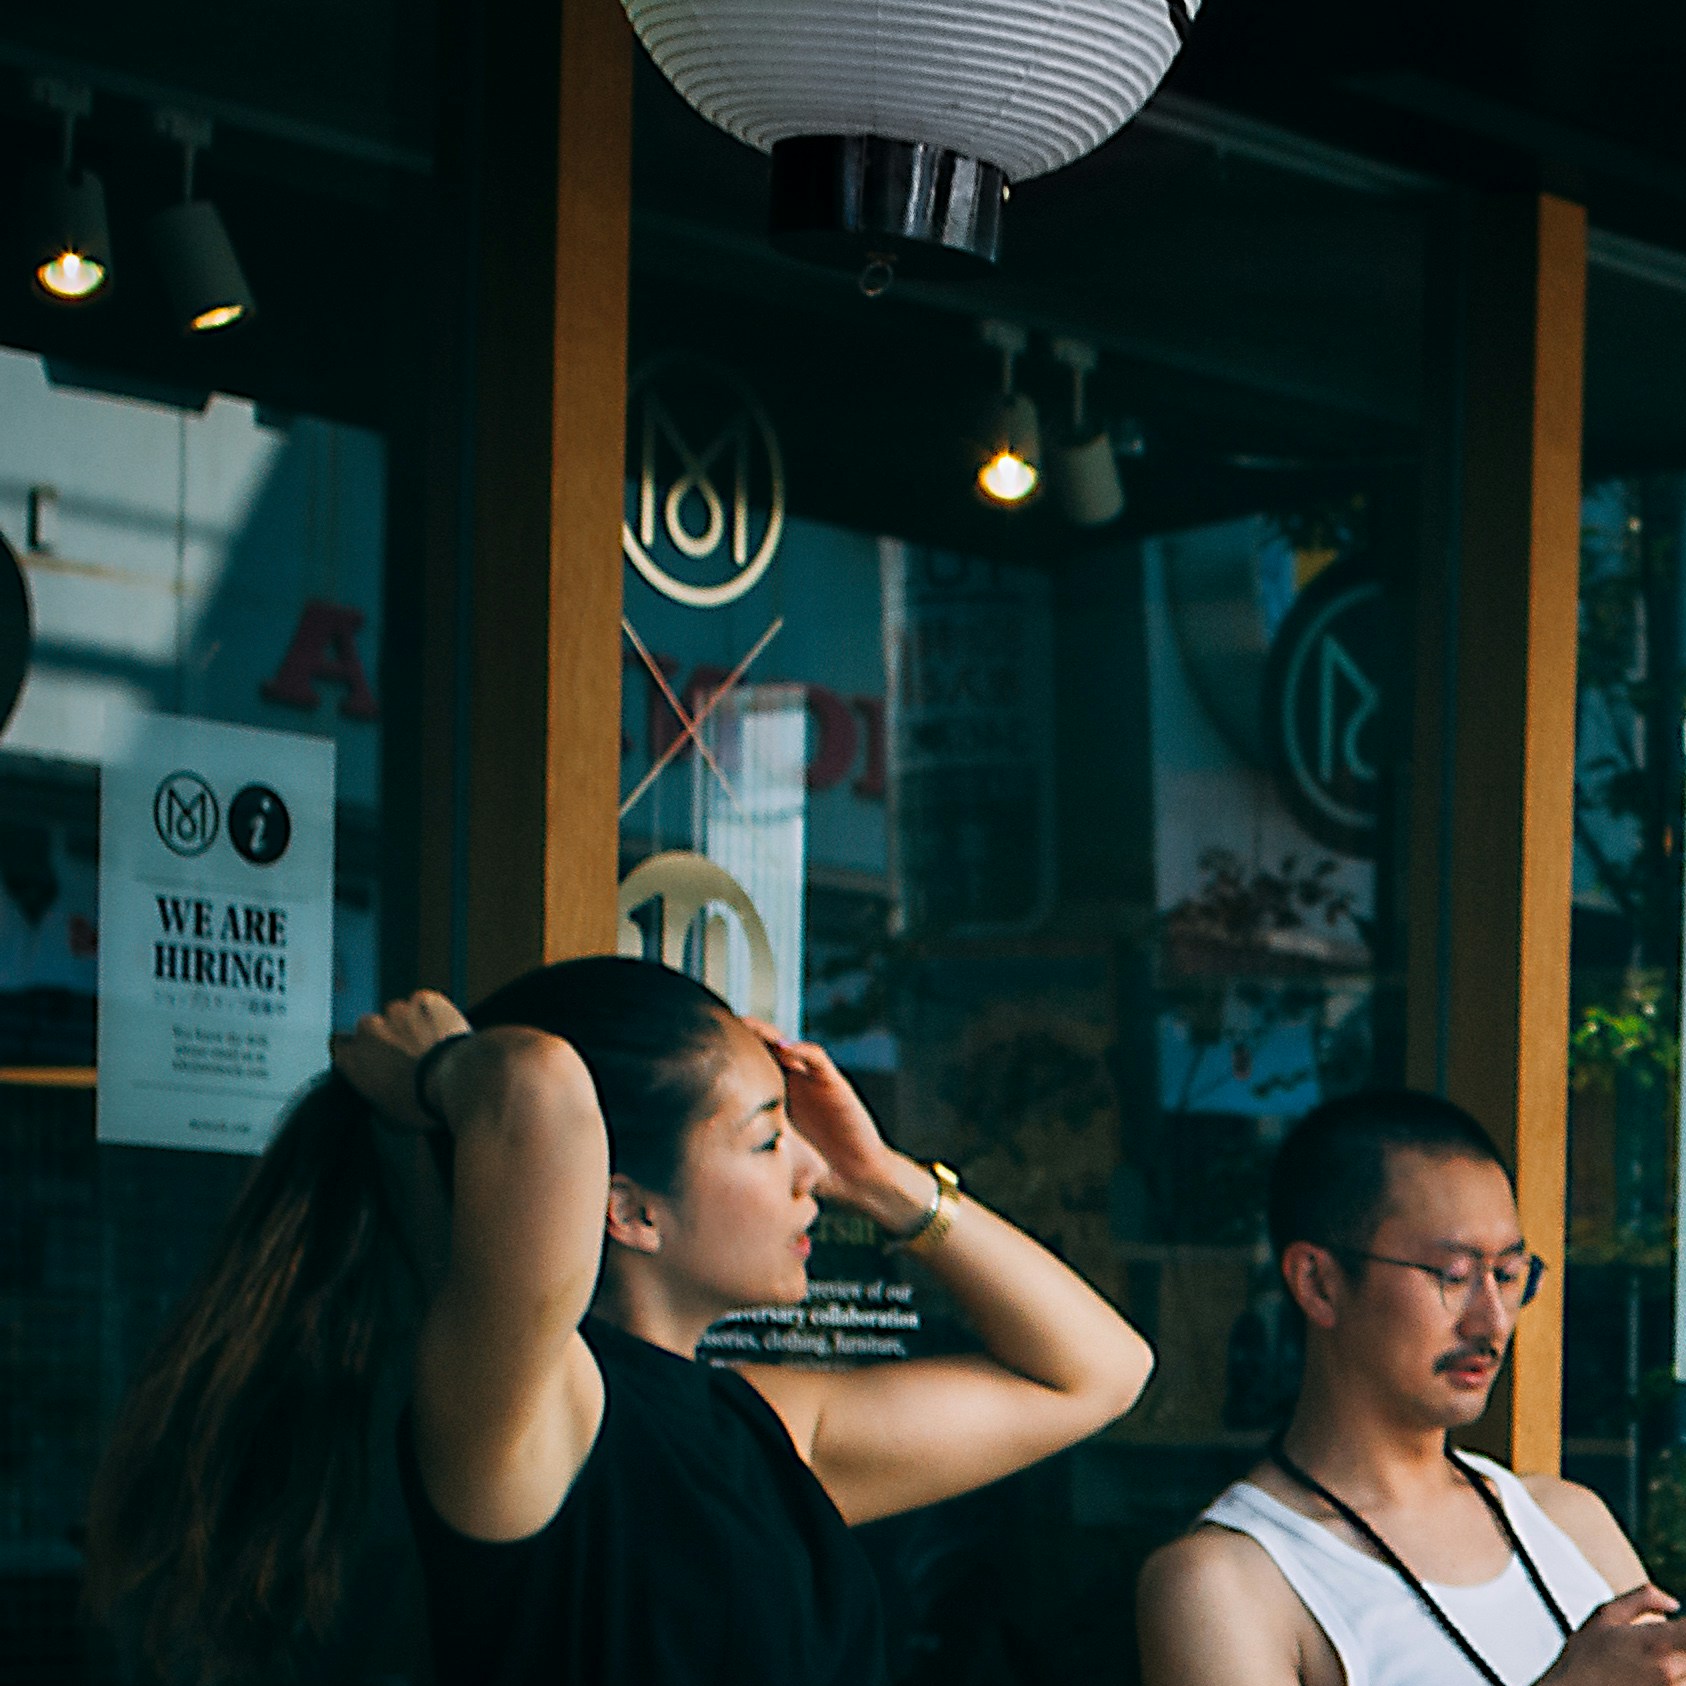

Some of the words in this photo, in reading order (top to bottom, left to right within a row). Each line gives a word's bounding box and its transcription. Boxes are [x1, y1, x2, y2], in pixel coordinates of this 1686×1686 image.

[157, 894, 213, 939] WE
[219, 902, 287, 947] ARE
[154, 941, 286, 994] HIRING!
